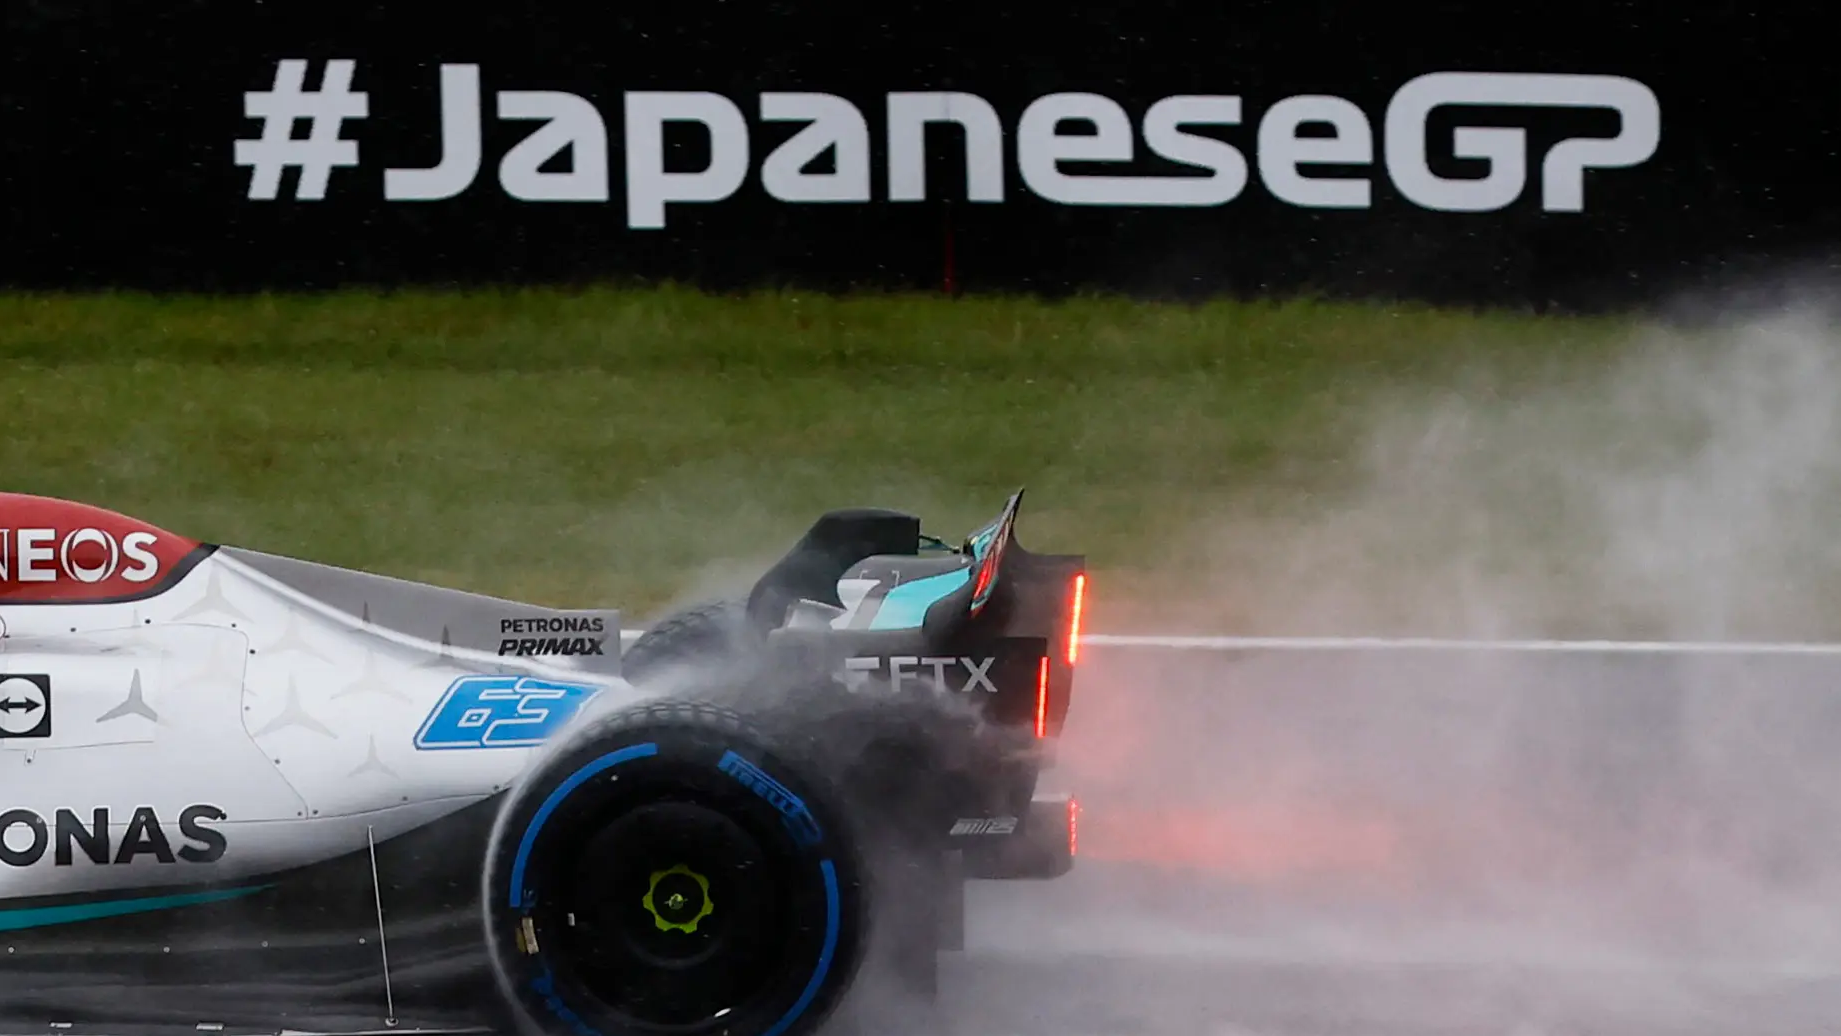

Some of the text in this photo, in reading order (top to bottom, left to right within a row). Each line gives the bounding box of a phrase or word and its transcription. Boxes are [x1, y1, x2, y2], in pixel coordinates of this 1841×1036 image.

[234, 59, 1661, 229] #JapaneseGP
[500, 617, 604, 633] PETRONAS
[498, 637, 604, 656] PRIMAX
[890, 656, 998, 692] FTX
[413, 674, 608, 750] 63
